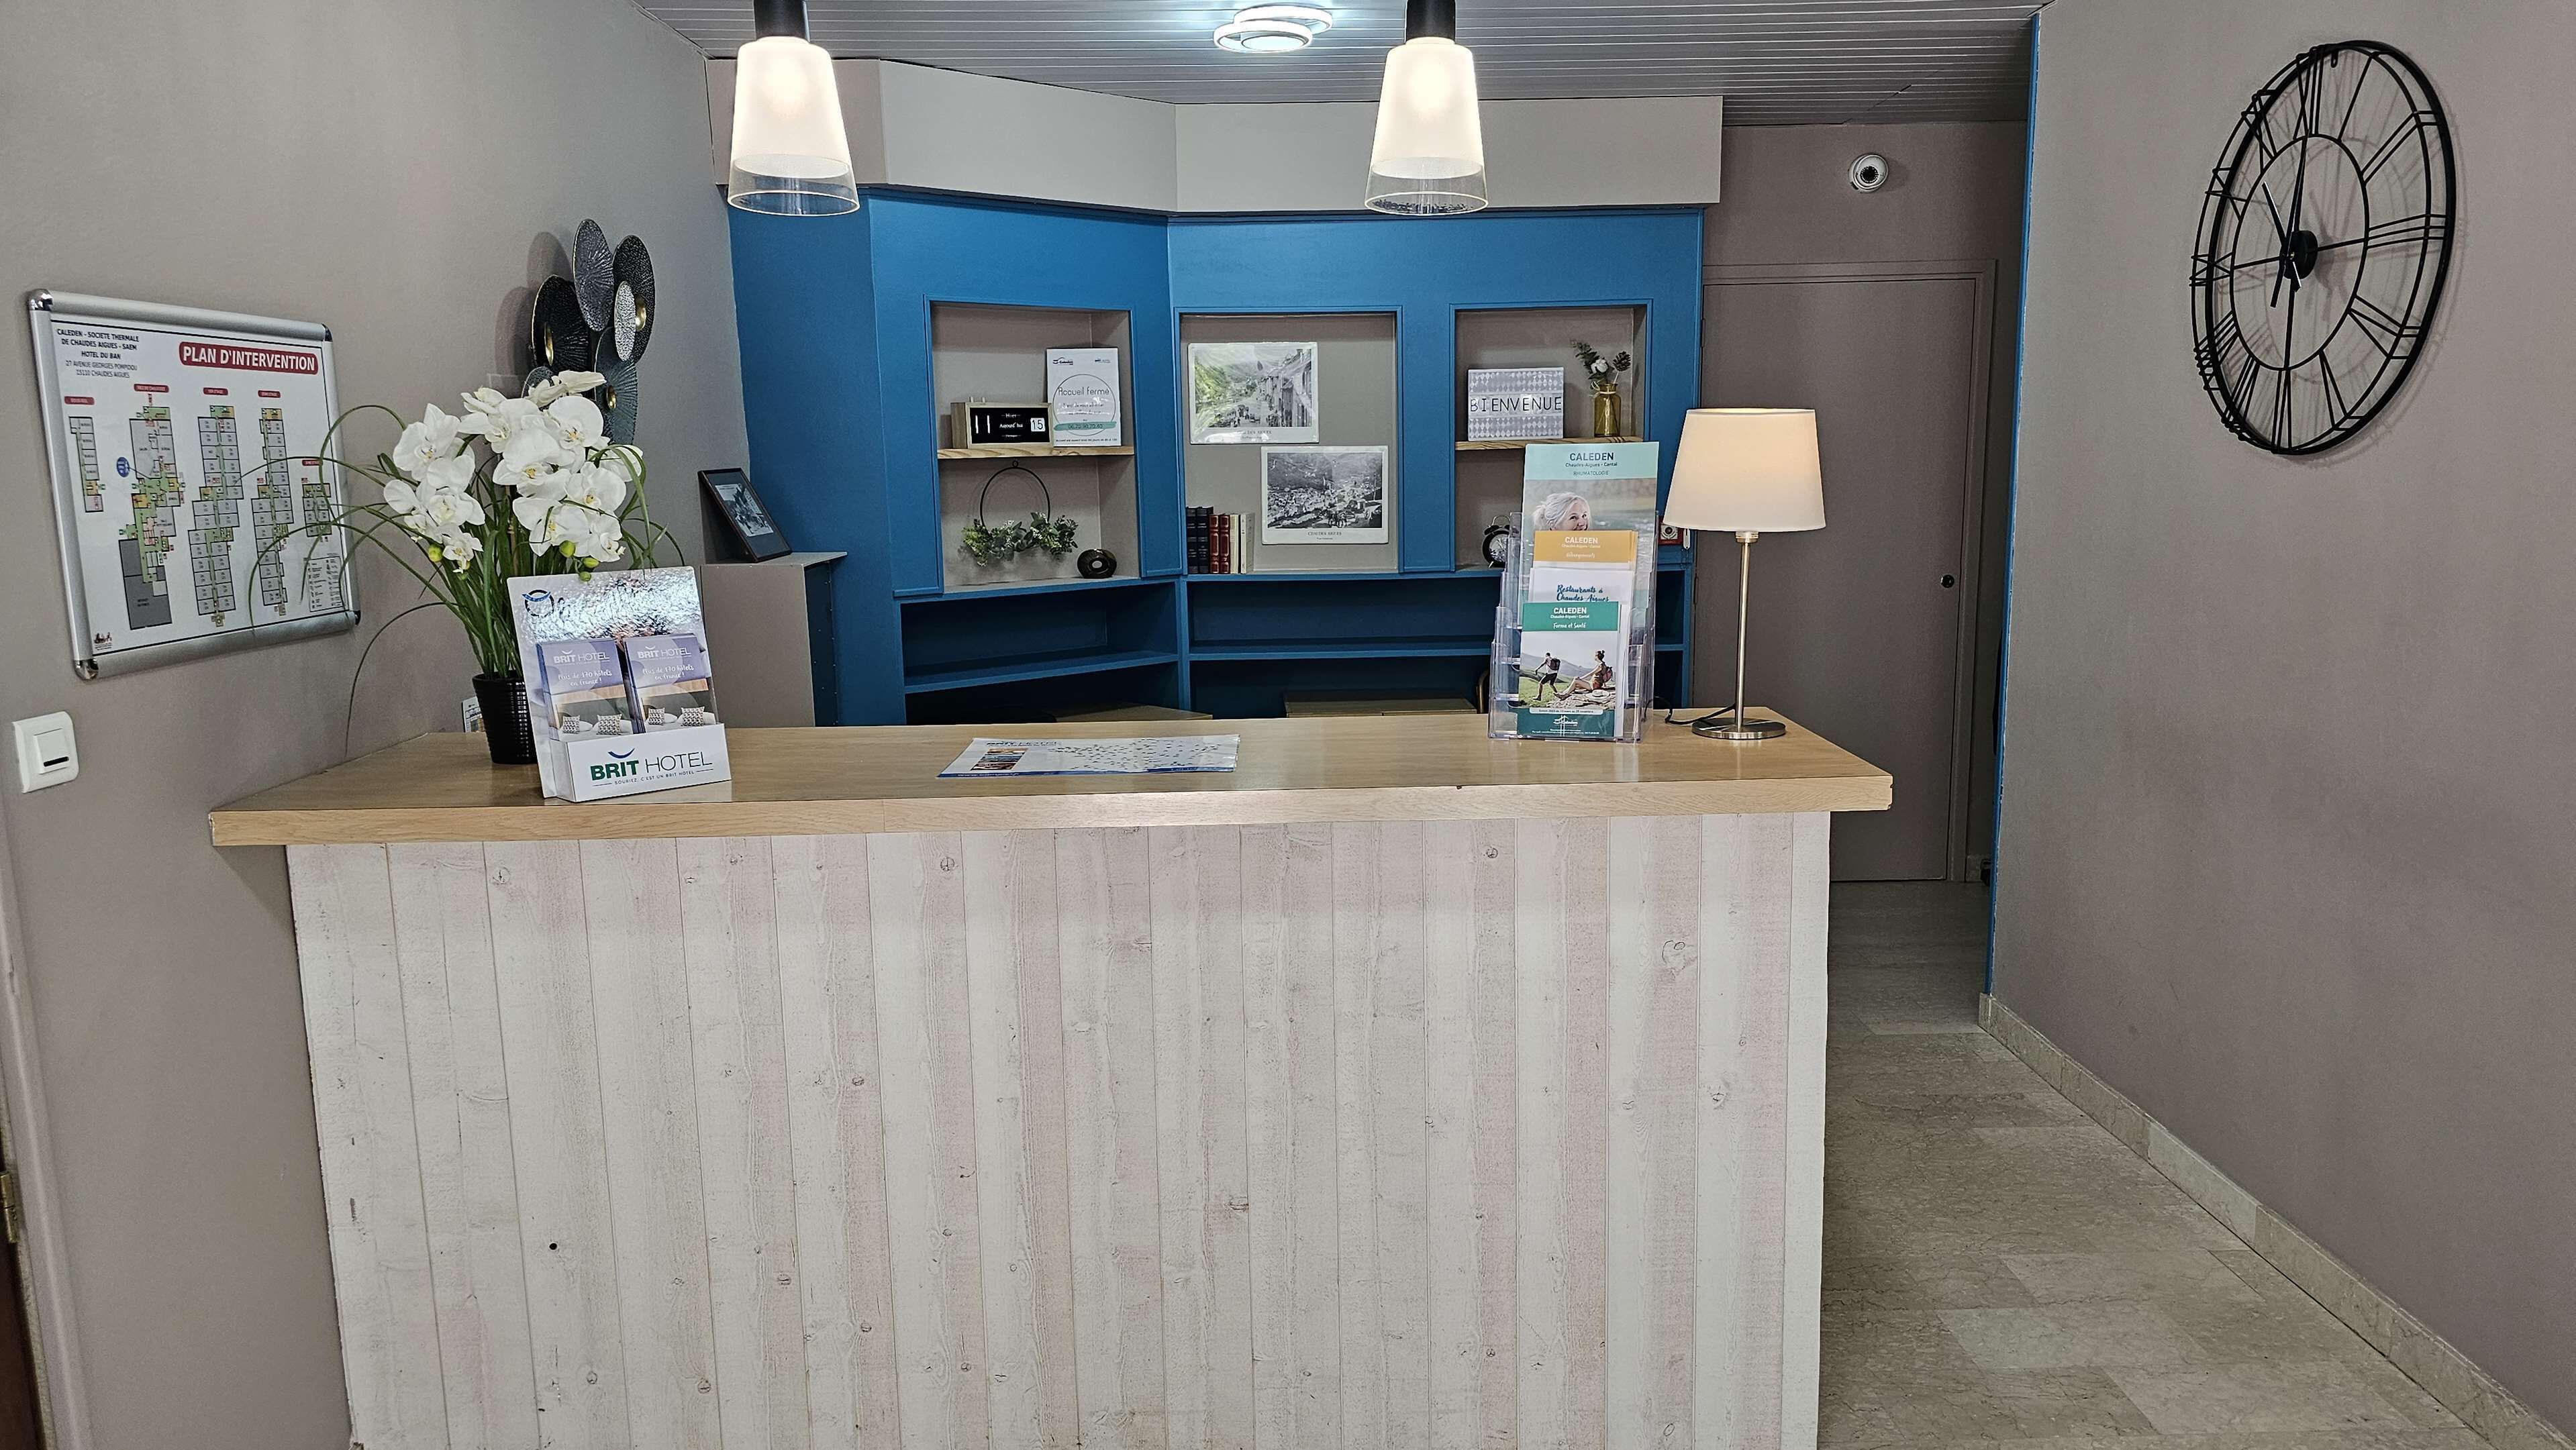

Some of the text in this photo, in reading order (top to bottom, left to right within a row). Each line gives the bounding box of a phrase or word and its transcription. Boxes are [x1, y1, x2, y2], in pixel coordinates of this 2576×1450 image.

[57, 329, 83, 337] CALEDEN
[88, 331, 110, 340] SOCIETE
[111, 333, 140, 342] THERMALE
[71, 339, 97, 348] CHAUDES
[183, 346, 315, 370] PLAN D'INTERVENTION
[1058, 386, 1084, 395] Accueil
[1471, 397, 1561, 412] BIENVENUE
[1032, 419, 1043, 429] 15
[1570, 452, 1614, 460] CALEDEN
[1557, 584, 1595, 593] Restaurants
[1557, 592, 1583, 601] Chaudes
[554, 652, 610, 664] BRIT HOTEL
[637, 648, 691, 658] BRIT HOTEL
[590, 752, 713, 781] BRIT HOTEL
